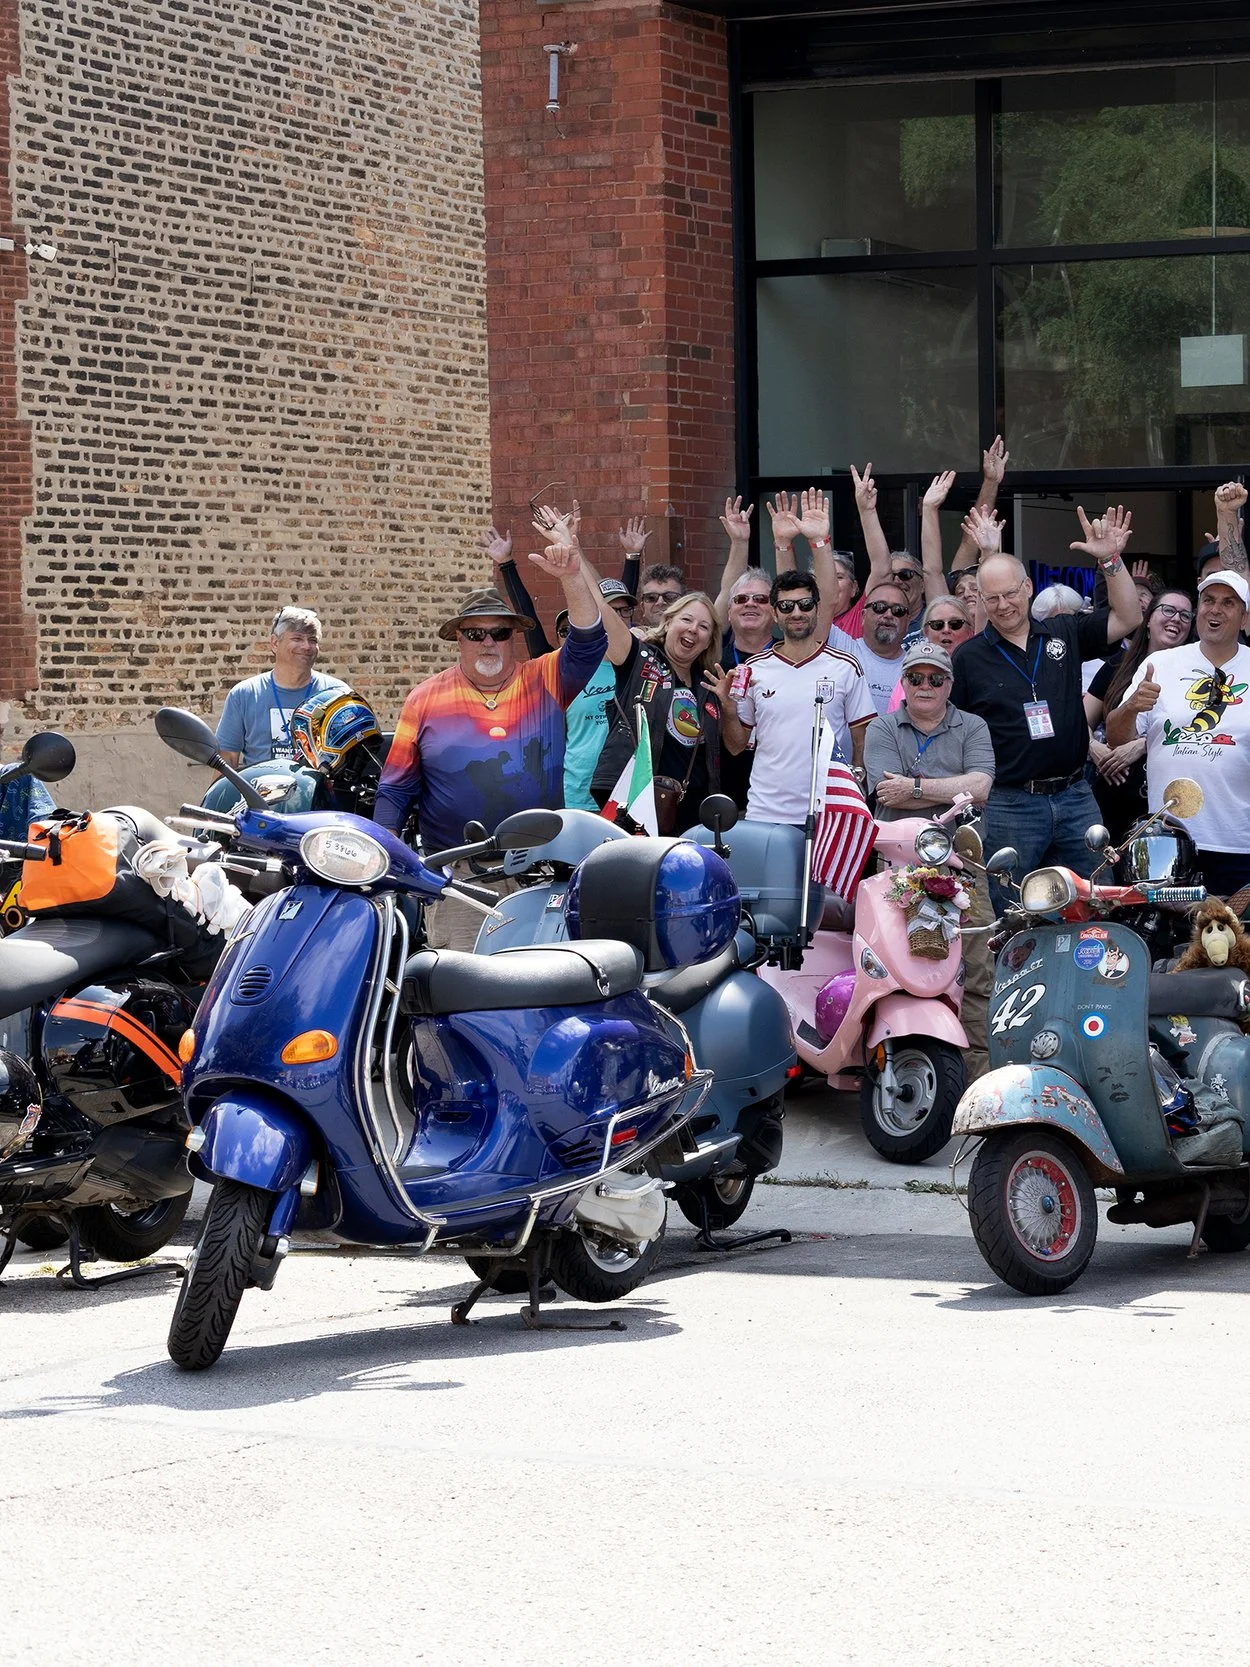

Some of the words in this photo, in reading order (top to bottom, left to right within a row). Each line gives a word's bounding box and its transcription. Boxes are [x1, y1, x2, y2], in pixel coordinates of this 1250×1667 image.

[1172, 744, 1198, 757] Italian
[1201, 744, 1224, 762] Style
[991, 984, 1046, 1036] 42
